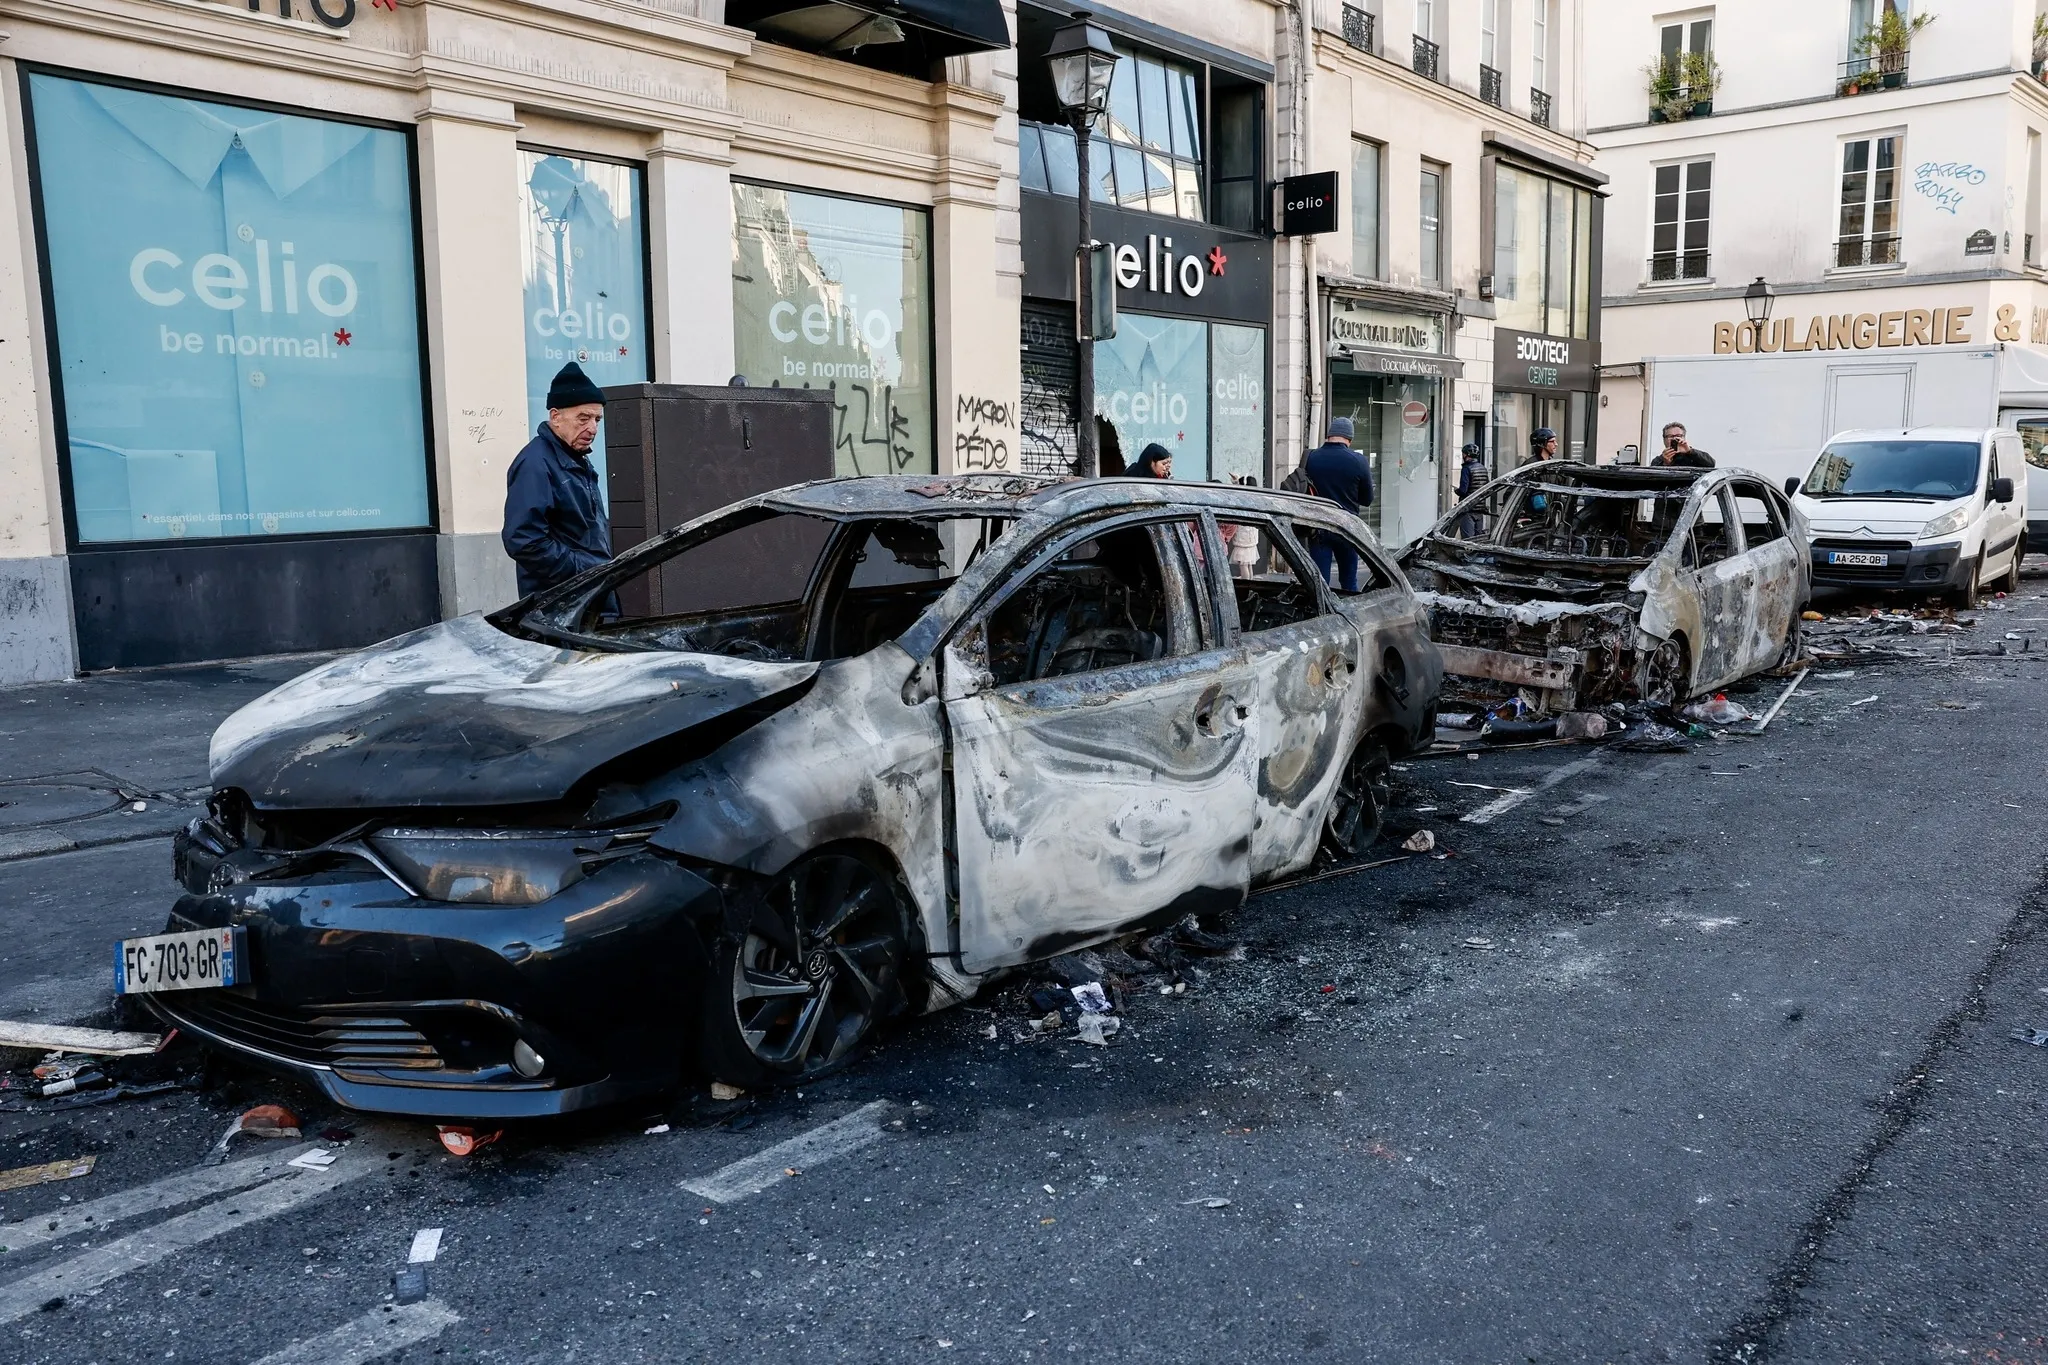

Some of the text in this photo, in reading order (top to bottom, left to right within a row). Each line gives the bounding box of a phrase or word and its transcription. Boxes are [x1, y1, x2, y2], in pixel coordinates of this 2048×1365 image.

[1287, 196, 1323, 211] celio
[130, 239, 358, 317] celio
[1090, 234, 1204, 297] elio
[533, 302, 631, 341] celio
[769, 294, 892, 349] celio
[1713, 306, 1974, 354] BOULANGERIE
[1994, 303, 2021, 342] &
[160, 324, 204, 353] be
[545, 345, 563, 360] be
[1516, 335, 1569, 365] BODYTECH
[783, 356, 806, 376] be
[1527, 366, 1557, 386] CENTER
[1215, 373, 1259, 400] celio
[956, 393, 1015, 429] MACRON
[1110, 382, 1188, 425] celio
[208, 511, 233, 521] dans
[236, 512, 254, 520] nos
[307, 509, 316, 518] et
[319, 510, 334, 518] sur
[1835, 554, 1881, 565] AA-252-QB
[126, 937, 219, 985] FC-703-GR
[222, 958, 232, 978] 75
